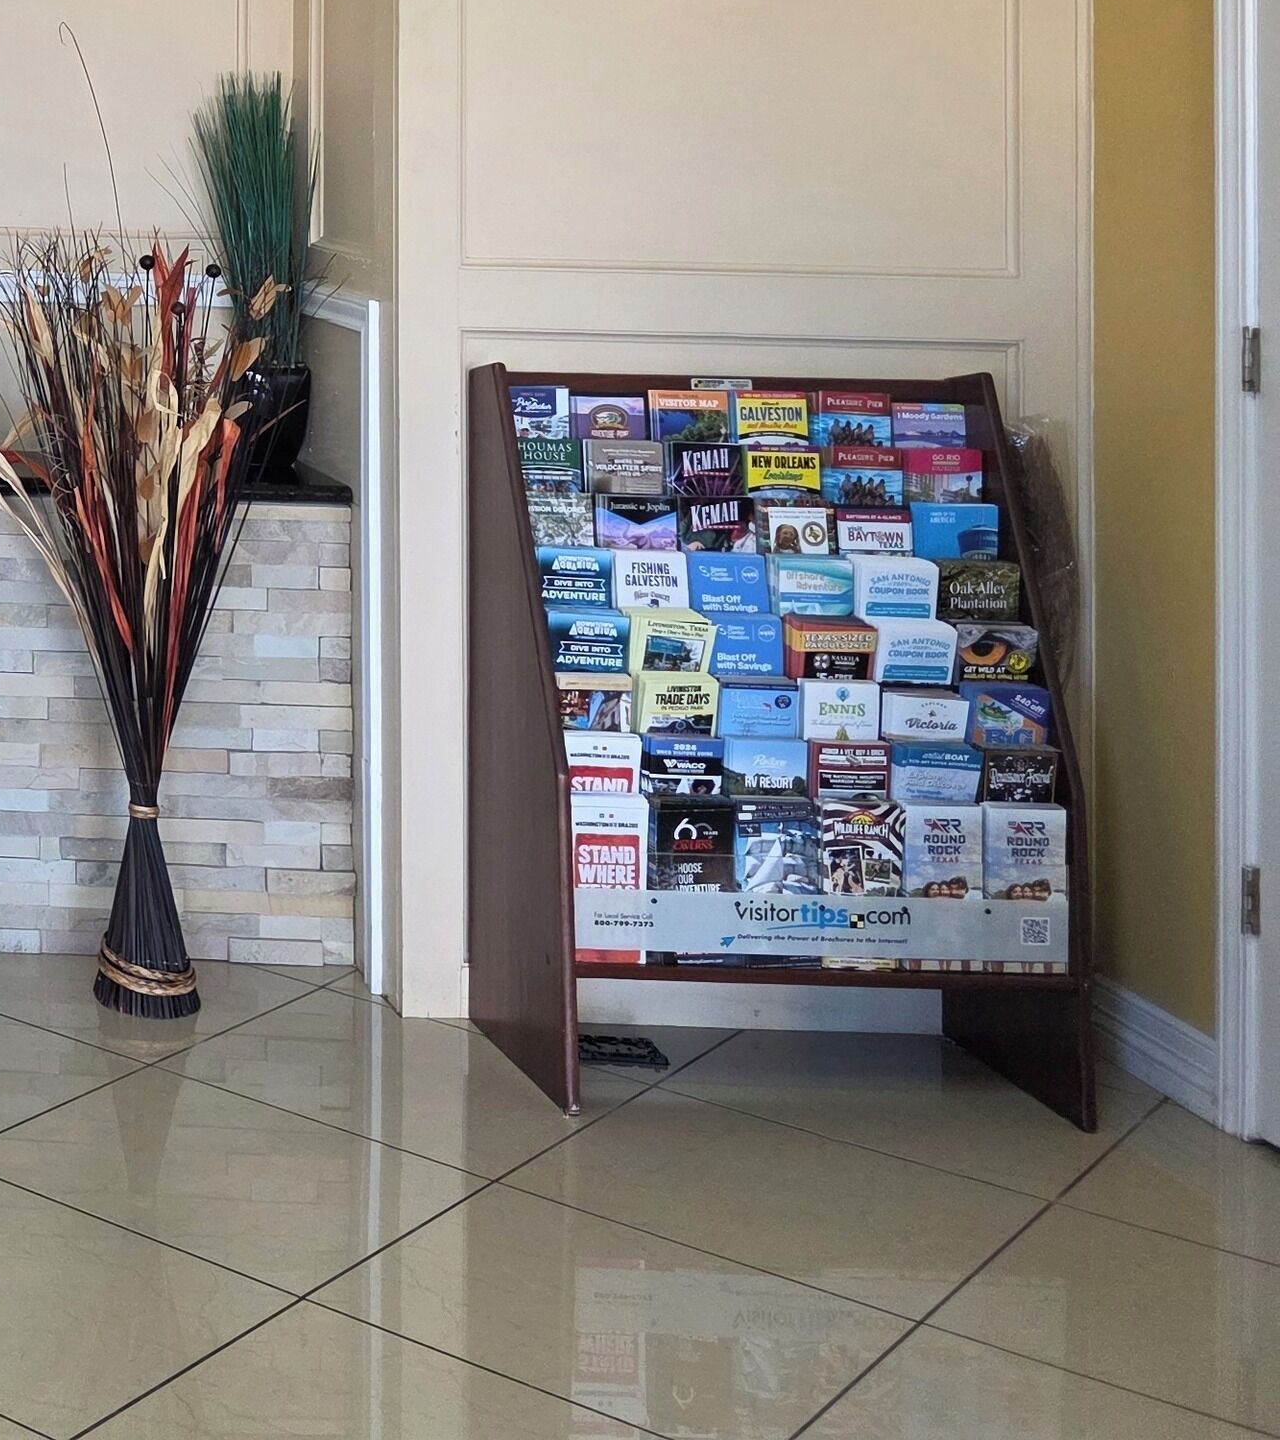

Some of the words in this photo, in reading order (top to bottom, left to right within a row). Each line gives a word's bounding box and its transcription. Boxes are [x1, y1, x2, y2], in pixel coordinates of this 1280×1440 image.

[658, 398, 697, 408] VISITOR
[699, 399, 719, 408] MAP
[826, 397, 863, 407] PLEASURE
[866, 398, 884, 408] PIER
[740, 406, 802, 422] GALVESTON
[902, 412, 930, 422] Moody
[930, 413, 963, 421] Gardens
[517, 441, 572, 453] HOUMAS
[524, 451, 566, 461] HOUSE
[838, 452, 873, 462] PLEASURE
[878, 453, 894, 462] PIER
[681, 448, 729, 478] KEMAH
[752, 455, 772, 468] NEW
[774, 456, 816, 470] ORLEANS
[596, 464, 640, 472] WILDCATTER
[640, 465, 662, 473] SPIRIT
[610, 501, 638, 511] Jurassic
[646, 502, 671, 513] Joplin
[690, 500, 739, 532] KEMAH
[848, 531, 903, 543] BAYTOWN
[879, 541, 904, 549] TEXAS
[551, 558, 600, 572] AQUARIUM
[631, 562, 670, 575] FISHING
[553, 579, 573, 587] DIVE
[574, 580, 594, 588] INTO
[625, 574, 678, 588] GALVESTON
[870, 574, 890, 587] SAN
[891, 573, 931, 587] ANTONIO
[869, 586, 904, 595] COUPON
[906, 587, 930, 596] BOOK
[949, 582, 973, 595] Oak
[973, 581, 1007, 595] Alley
[542, 590, 606, 601] ADVENTURE
[701, 594, 725, 603] Blast
[725, 594, 741, 603] Off
[702, 603, 723, 611] with
[723, 603, 758, 613] Savings
[950, 597, 1007, 610] Plantation
[569, 623, 618, 637] AQUARIUM
[570, 644, 589, 652] DIVE
[591, 645, 611, 653] INTO
[805, 641, 847, 649] PAYOUTS
[890, 638, 910, 649] SAN
[911, 637, 951, 651] ANTONIO
[717, 653, 741, 662] Blast
[741, 652, 757, 662] Off
[831, 654, 860, 662] NASKILA
[888, 650, 923, 659] COUPON
[925, 650, 949, 659] BOOK
[556, 655, 623, 667] ADVENTURE
[717, 662, 736, 670] with
[737, 662, 773, 672] Savings
[978, 666, 995, 674] WILD
[666, 685, 702, 693] LIVINGSTON
[655, 693, 684, 705] TRADE
[686, 693, 710, 705] DAYS
[1014, 694, 1031, 707] $40
[818, 702, 866, 718] ENNIS
[905, 717, 959, 731] Victoria
[944, 754, 970, 762] BOAT
[571, 776, 629, 791] STAND
[745, 776, 758, 788] RV
[759, 776, 794, 789] RESORT
[834, 822, 864, 835] WILDLIFE
[864, 824, 889, 838] RANCH
[923, 834, 966, 844] ROUND
[1007, 836, 1050, 847] ROUND
[672, 842, 715, 851] CAVERNS
[928, 845, 961, 855] ROCK
[577, 845, 636, 864] STAND
[1011, 848, 1045, 858] ROCK
[578, 864, 636, 884] WHERE
[734, 900, 911, 929] visitortips.com
[737, 933, 772, 942] Delivering
